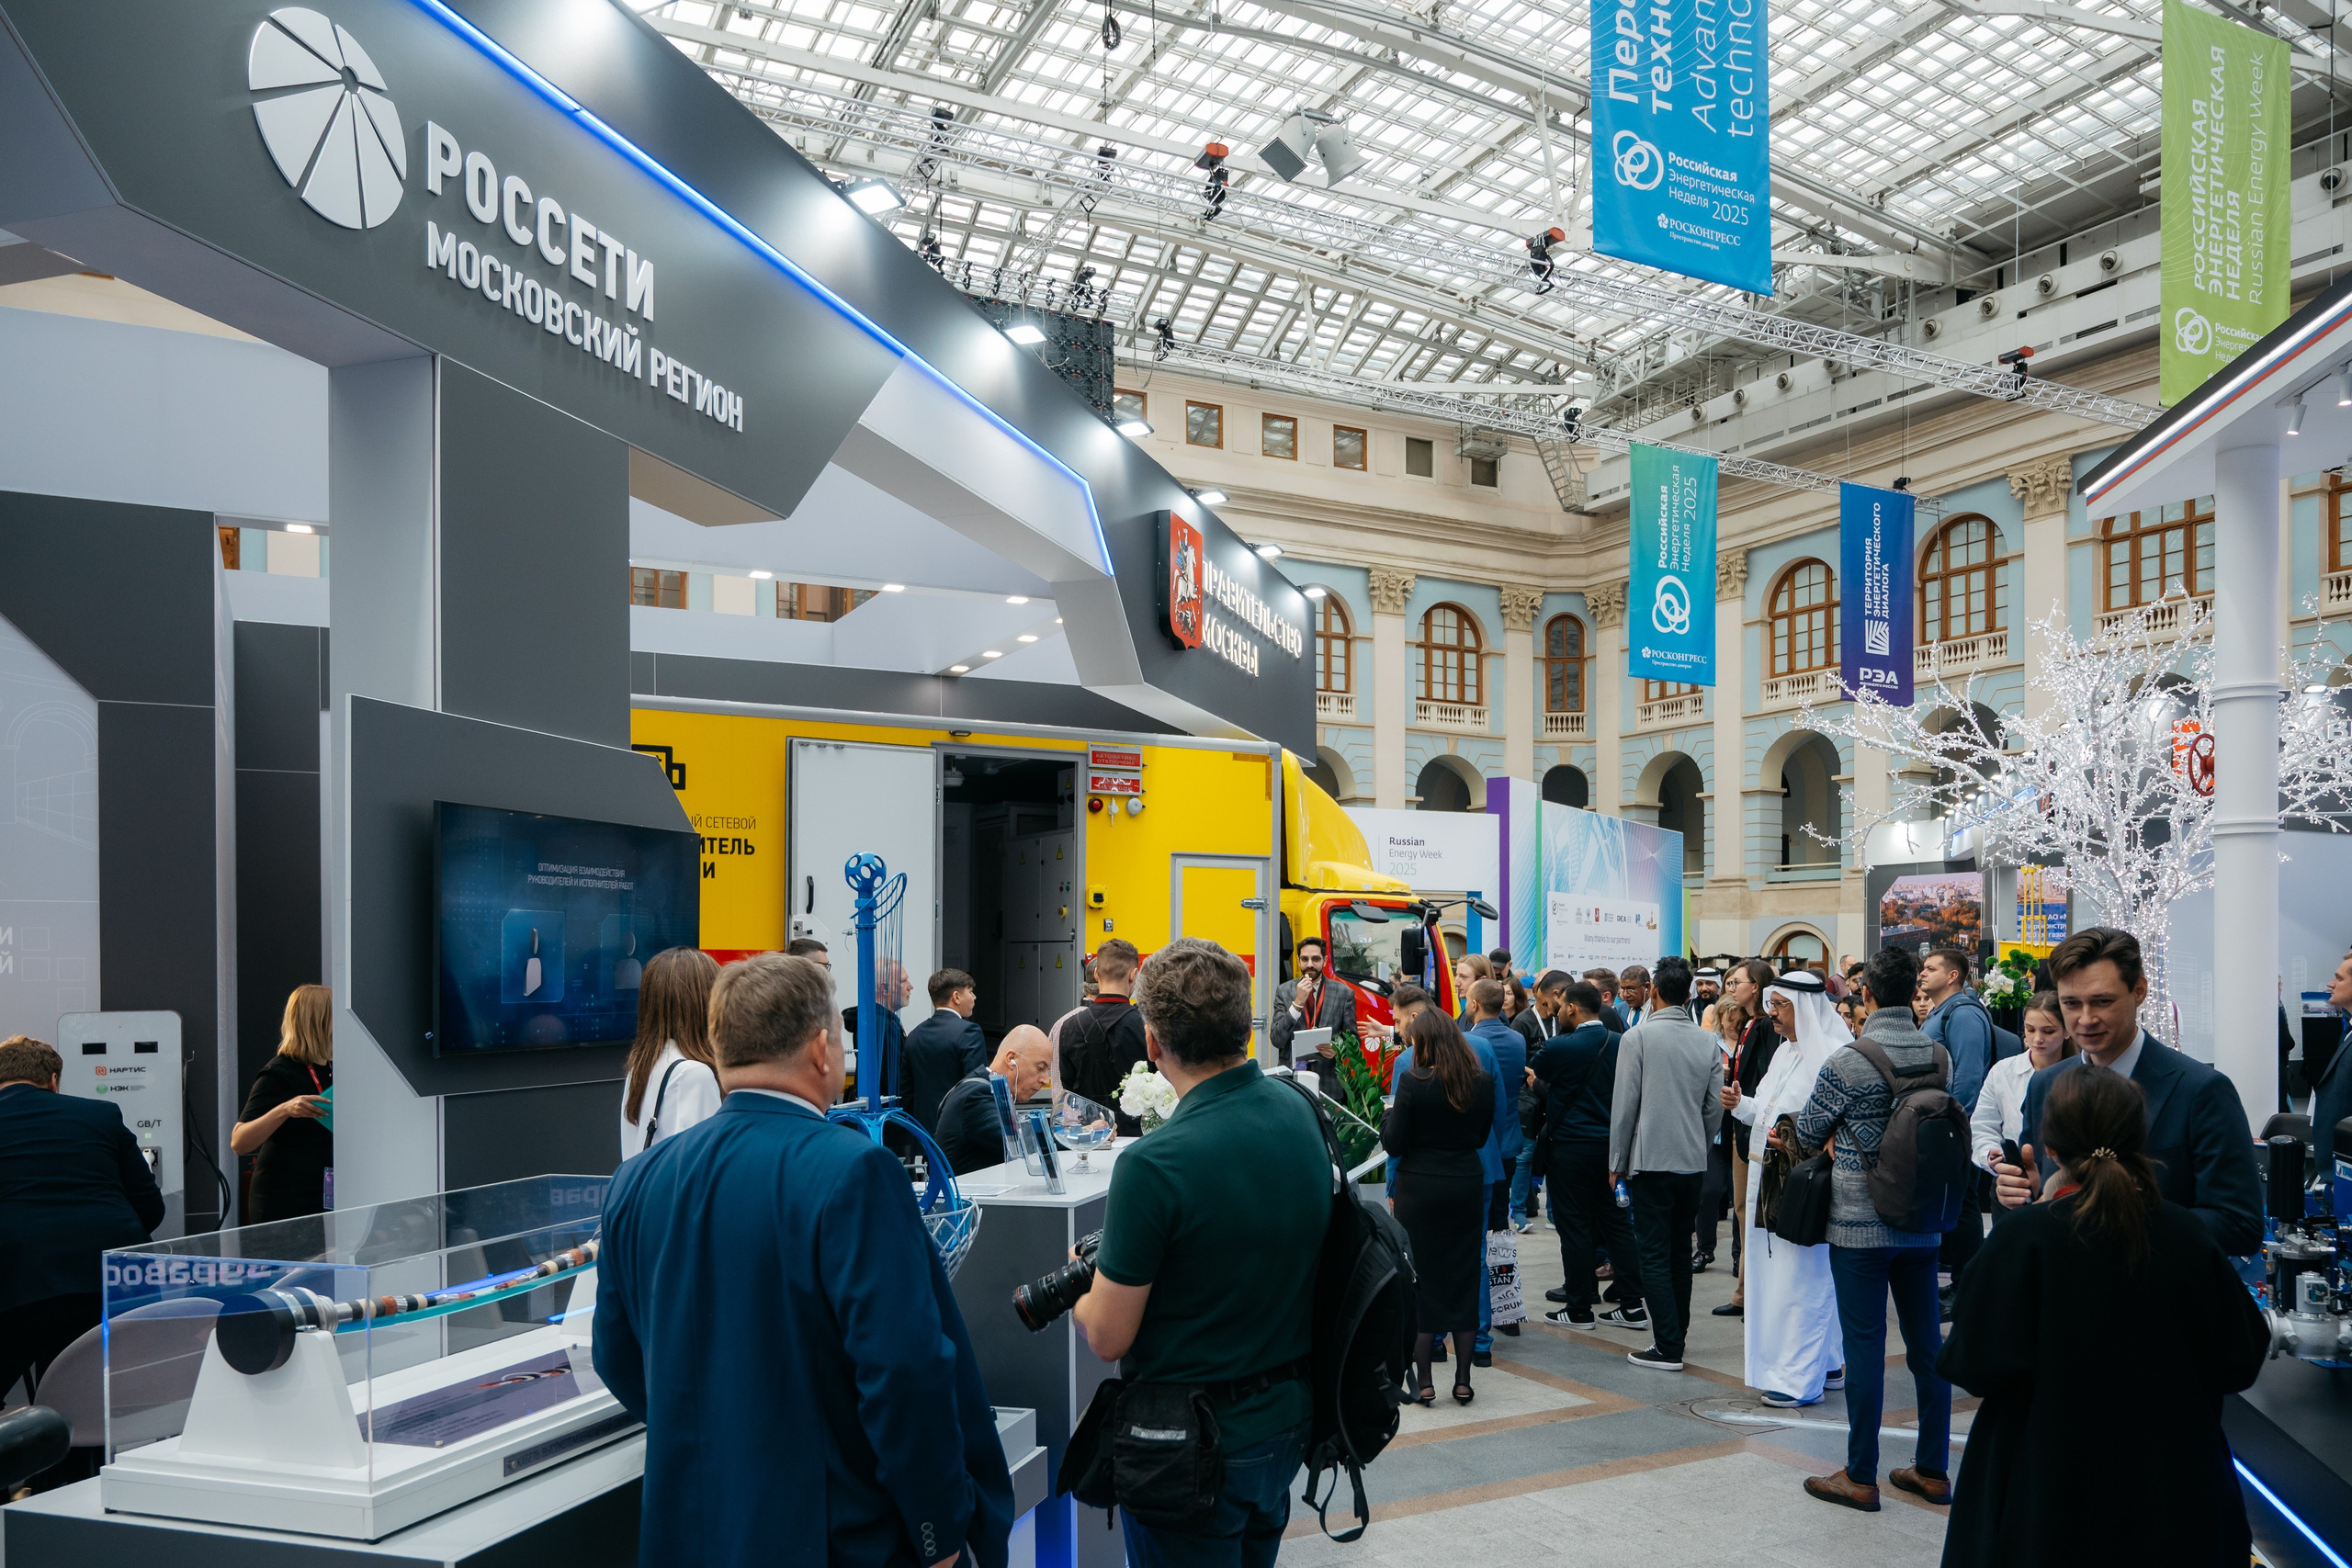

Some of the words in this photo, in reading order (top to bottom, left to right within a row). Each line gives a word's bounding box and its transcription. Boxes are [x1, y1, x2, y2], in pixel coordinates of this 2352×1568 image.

[2249, 51, 2264, 118] Week
[1668, 151, 1737, 182] Российская
[2209, 46, 2225, 297] ЭНЕРГЕТИЧЕСКАЯ
[2248, 123, 2267, 204] Energy
[1668, 168, 1755, 204] Энергетическая
[1668, 186, 1709, 209] Неделя
[1712, 201, 1749, 226] 2025
[2189, 98, 2207, 290] РОССИЙСКАЯ
[426, 120, 655, 321] РОССЕТИ
[1669, 218, 1741, 247] РОСКОНГРЕСС
[2226, 190, 2242, 300] НЕДЕЛЯ
[2249, 212, 2264, 305] Russian
[426, 220, 643, 379] МОСКОВСКИЙ
[650, 347, 743, 433] РЕГИОН
[1670, 465, 1680, 570] Энергетическая
[1683, 477, 1698, 521] 2025
[1657, 485, 1668, 569] Российская
[1681, 524, 1691, 572] Неделя
[1873, 502, 1882, 617] ЭНЕРГЕТИЧЕСКОГО
[1882, 562, 1890, 619] ДИАЛОГА
[1652, 649, 1707, 664] РОСКОНГРЕСС
[1860, 667, 1899, 685] РЭА
[1095, 752, 1137, 761] АВТОМАТИКА
[1097, 758, 1136, 766] ОТКЛЮЧЕНА
[706, 815, 756, 830] СЕТЕВОЙ
[1389, 837, 1425, 846] Russian
[537, 863, 578, 874] ОПТИМИЗАЦИЯ
[578, 865, 626, 878] ВЗАИМОДЕЙСТВИЯ
[1389, 849, 1418, 861] Energy
[1419, 850, 1442, 859] Week
[1389, 863, 1418, 875] 2025
[527, 874, 573, 886] РУКОВОДИТЕЛЕЙ
[573, 877, 579, 886] И
[579, 878, 618, 890] ИСПОЛНИТЕЛЕЙ
[618, 881, 634, 891] РАБОТ
[137, 1119, 163, 1129] GB/T
